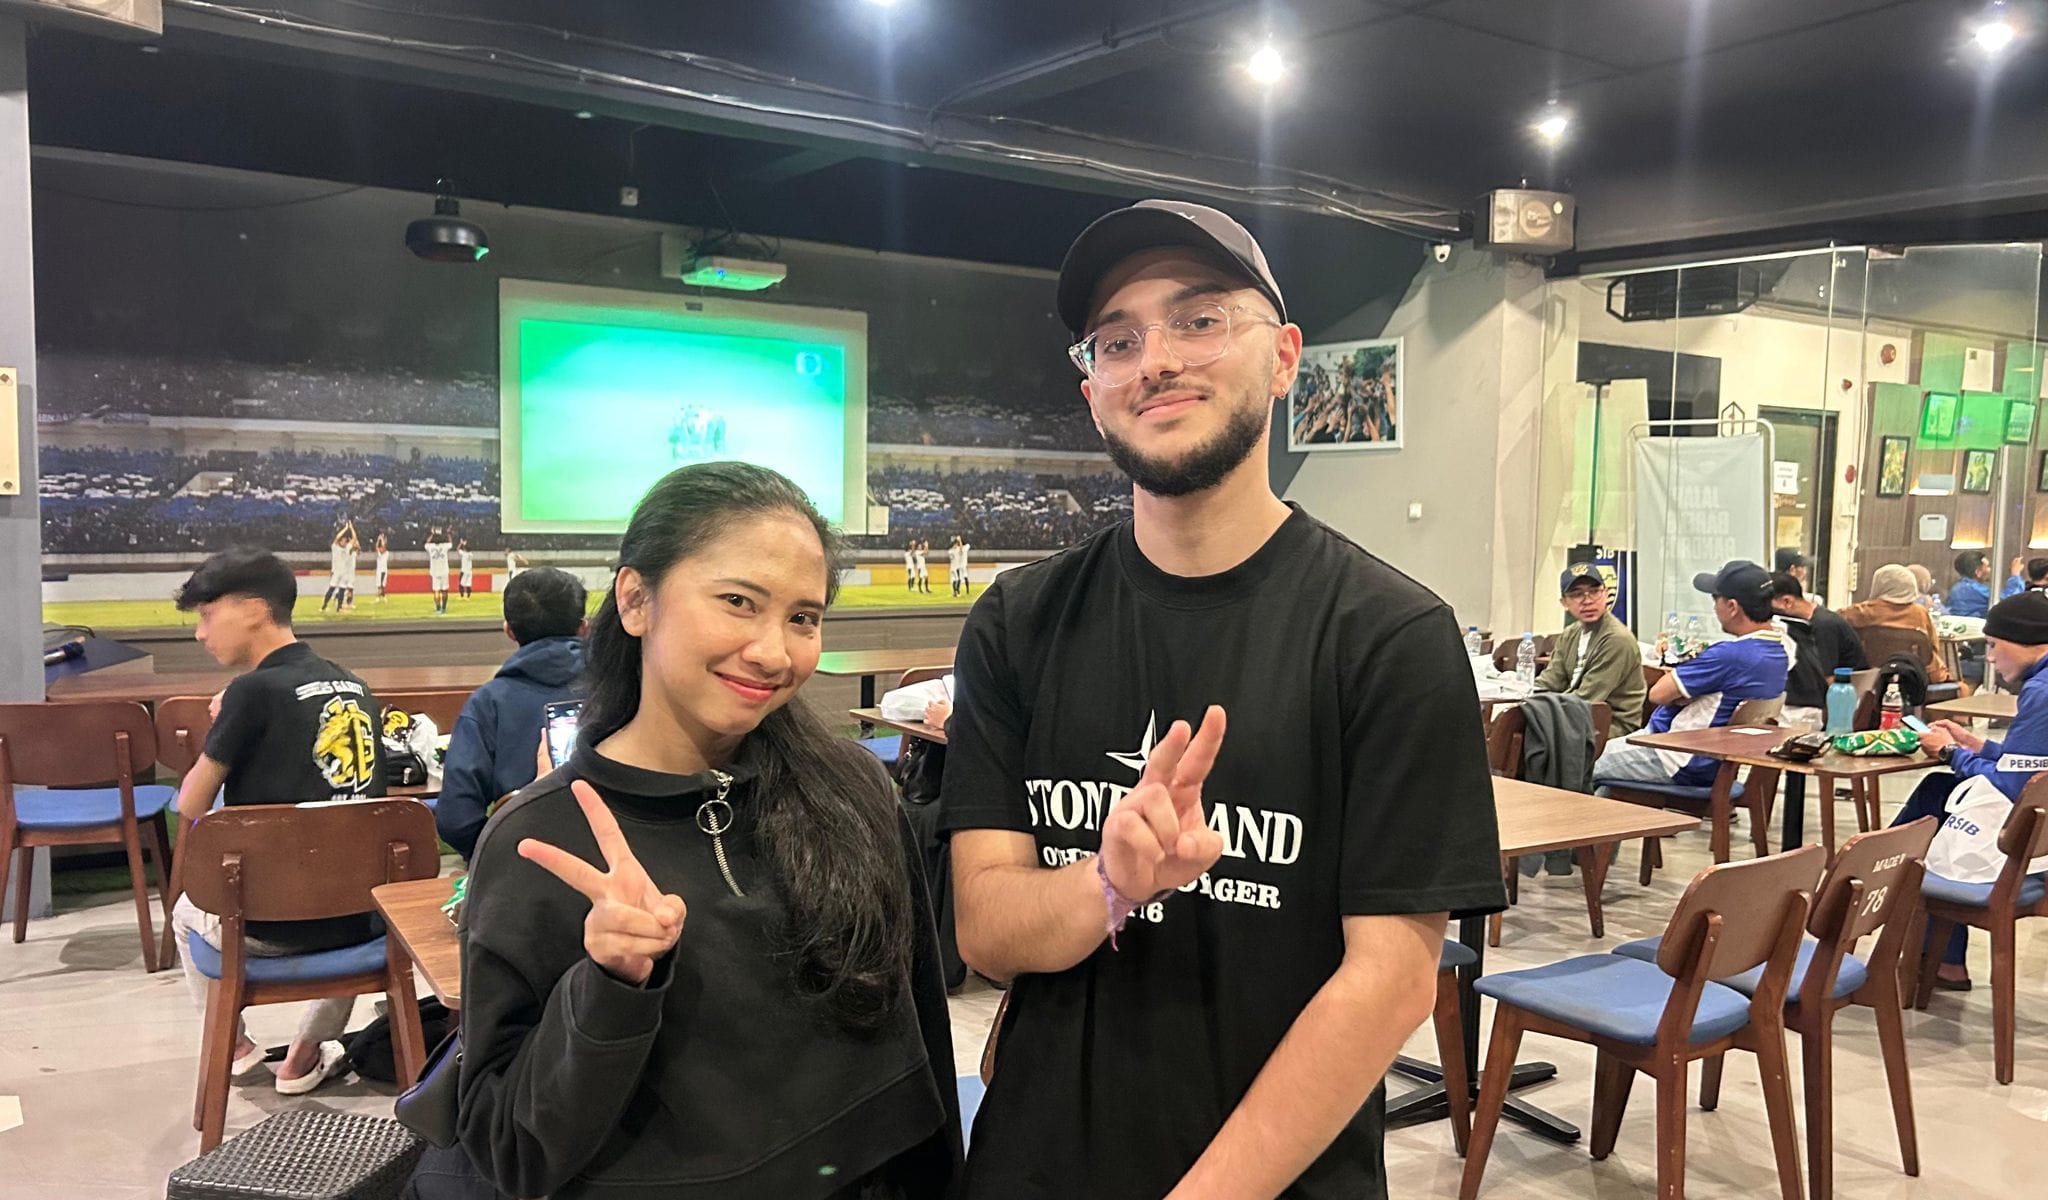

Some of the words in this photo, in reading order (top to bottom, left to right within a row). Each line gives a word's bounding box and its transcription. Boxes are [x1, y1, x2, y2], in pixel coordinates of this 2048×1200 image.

[2010, 758, 2048, 769] PERSIB
[1207, 801, 1304, 865] AND
[1944, 815, 1981, 836] RSIB
[1861, 886, 1888, 916] 78
